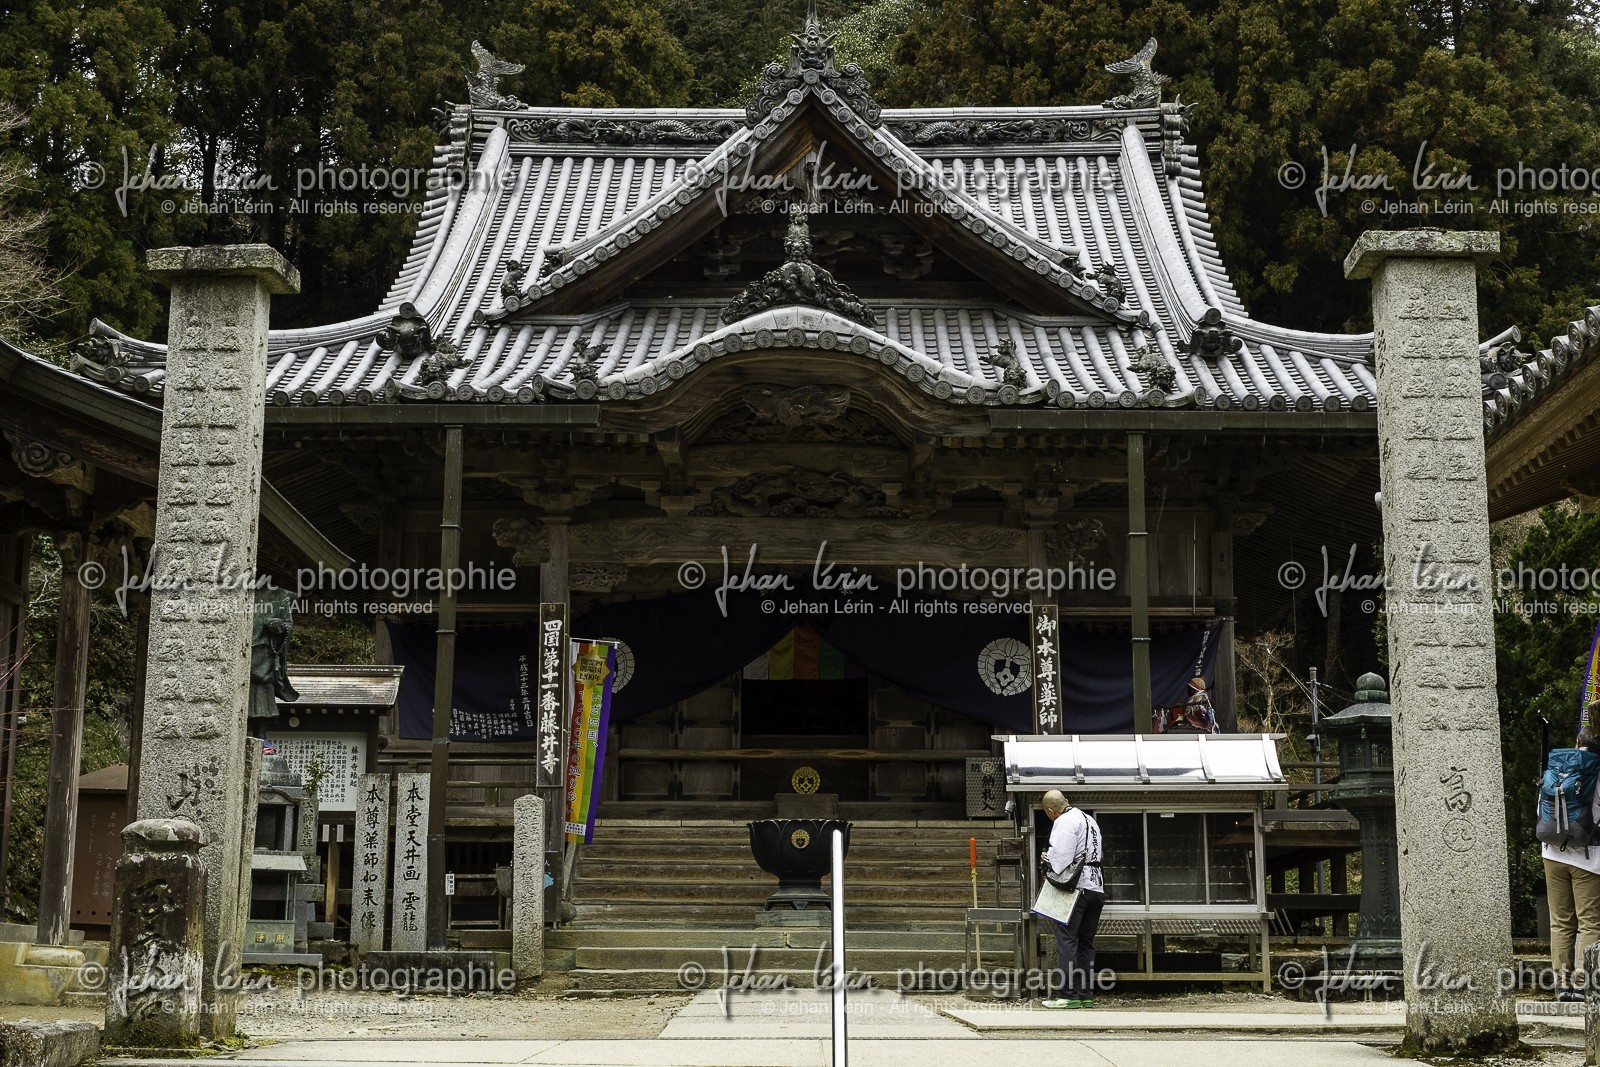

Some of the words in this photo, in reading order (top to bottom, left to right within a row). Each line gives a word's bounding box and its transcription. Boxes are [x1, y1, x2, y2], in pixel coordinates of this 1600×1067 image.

[540, 619, 563, 775] 四国第十一番藤井寺
[402, 782, 424, 881] 本堂天井画
[981, 775, 997, 811] 納札入
[360, 784, 384, 930] 本尊薬師如来像
